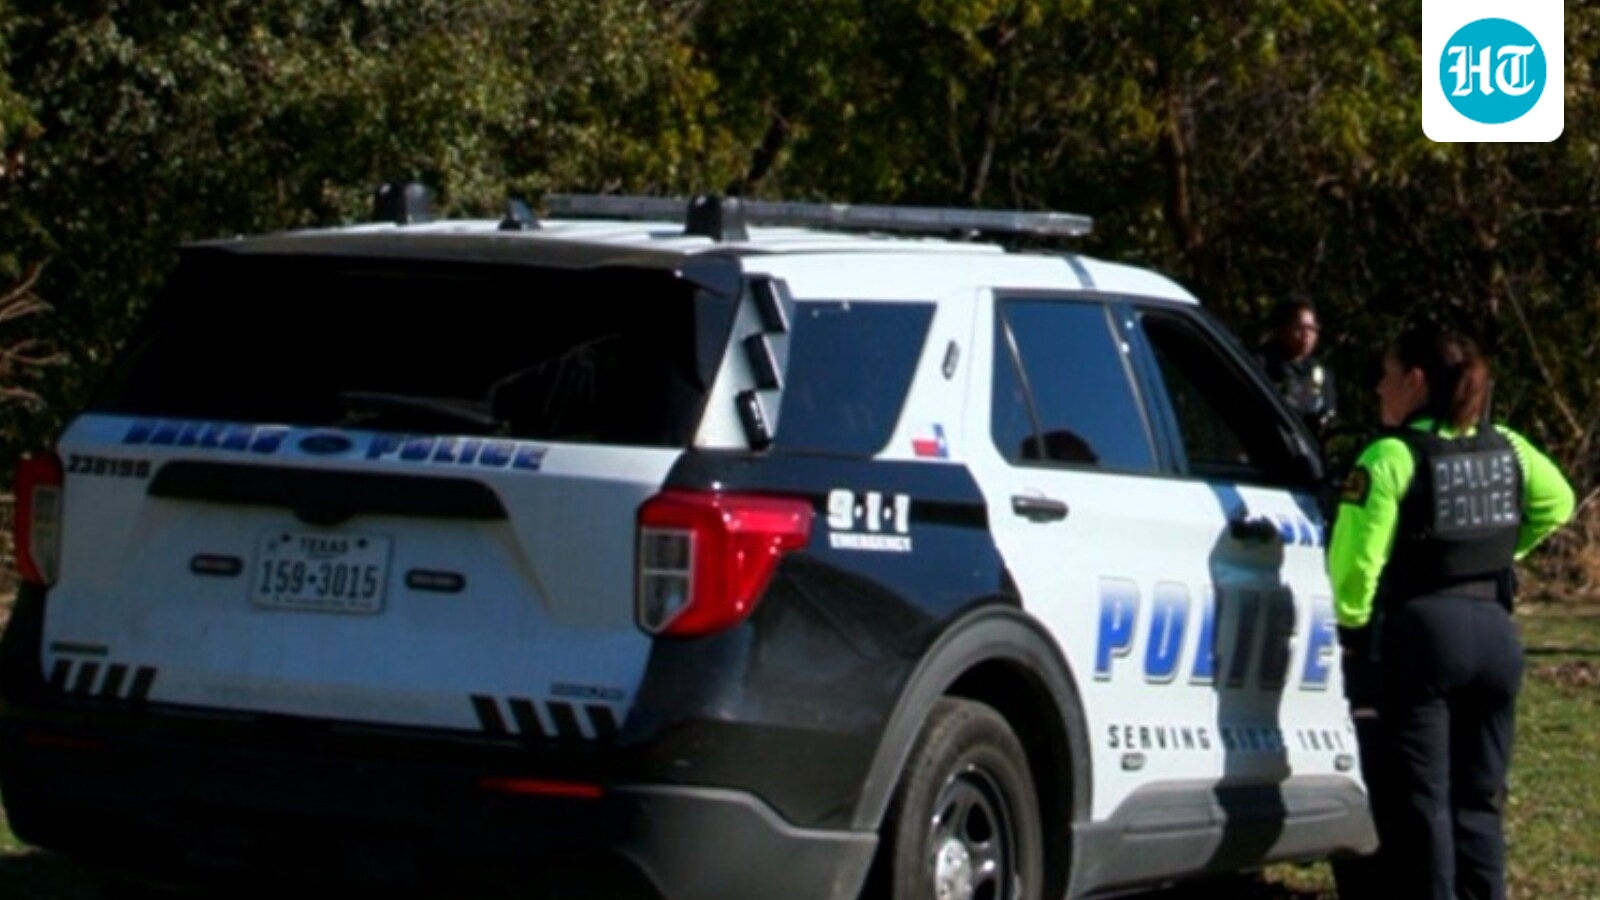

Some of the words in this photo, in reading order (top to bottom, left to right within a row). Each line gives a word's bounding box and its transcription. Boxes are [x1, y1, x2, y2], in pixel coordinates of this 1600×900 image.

[366, 437, 544, 471] POLICE
[1436, 455, 1514, 491] DALLAS
[1437, 490, 1515, 525] POLICE
[300, 536, 349, 554] TEXAS
[1093, 575, 1337, 691] POLICE
[1107, 724, 1212, 750] SERVING
